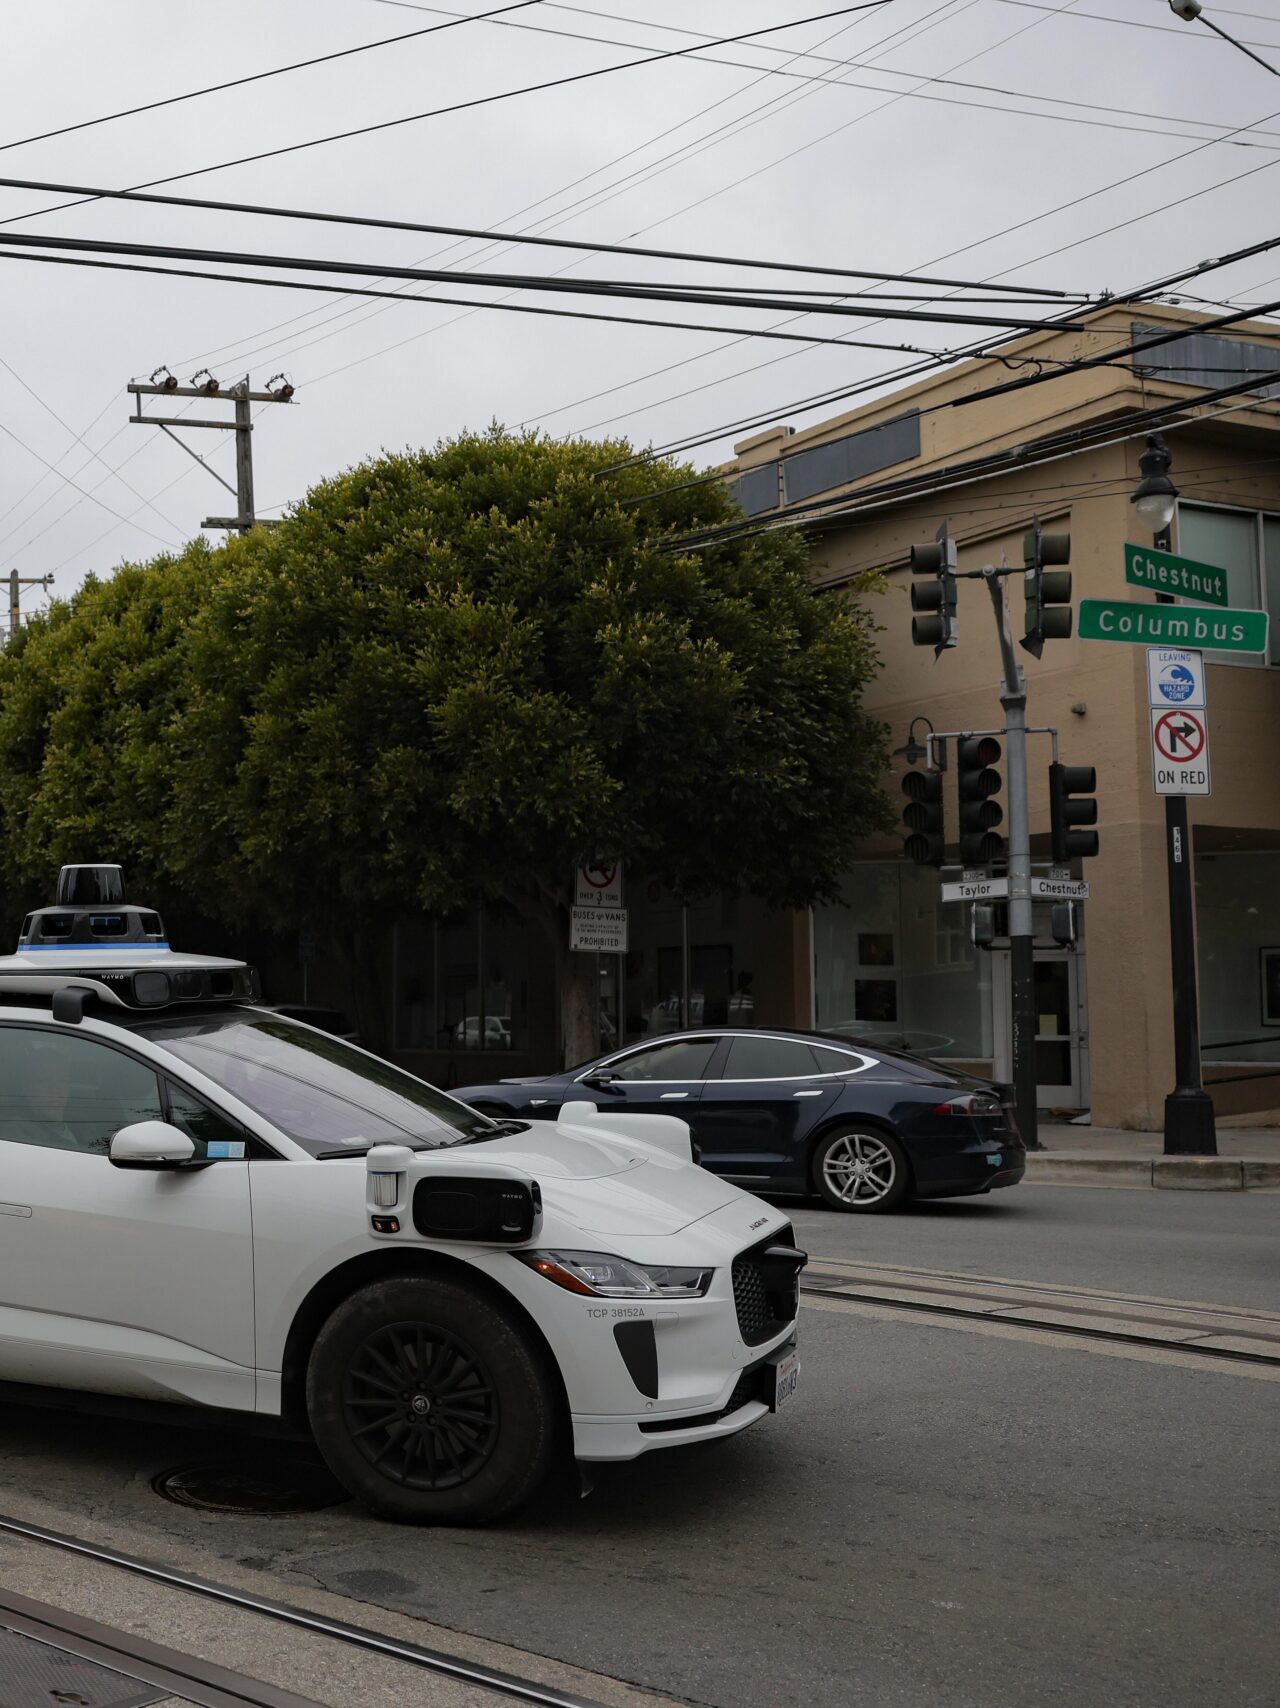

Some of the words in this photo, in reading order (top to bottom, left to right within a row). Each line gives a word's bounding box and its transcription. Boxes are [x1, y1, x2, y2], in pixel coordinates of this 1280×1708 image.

[1131, 554, 1223, 597] Chestnut
[1098, 609, 1245, 642] Columbus
[1159, 652, 1192, 662] LEAVING
[1163, 684, 1190, 693] HAZARD
[1168, 691, 1186, 700] ZONE
[1158, 770, 1175, 784] ON
[1180, 770, 1206, 785] RED
[959, 884, 991, 898] Taylor
[1039, 882, 1081, 896] Chestnut
[597, 891, 602, 902] 3
[573, 910, 595, 920] BUSES
[605, 912, 626, 922] VANS
[579, 936, 619, 947] PROHIBITED
[586, 1308, 608, 1319] TCP
[611, 1307, 645, 1318] 38152A
